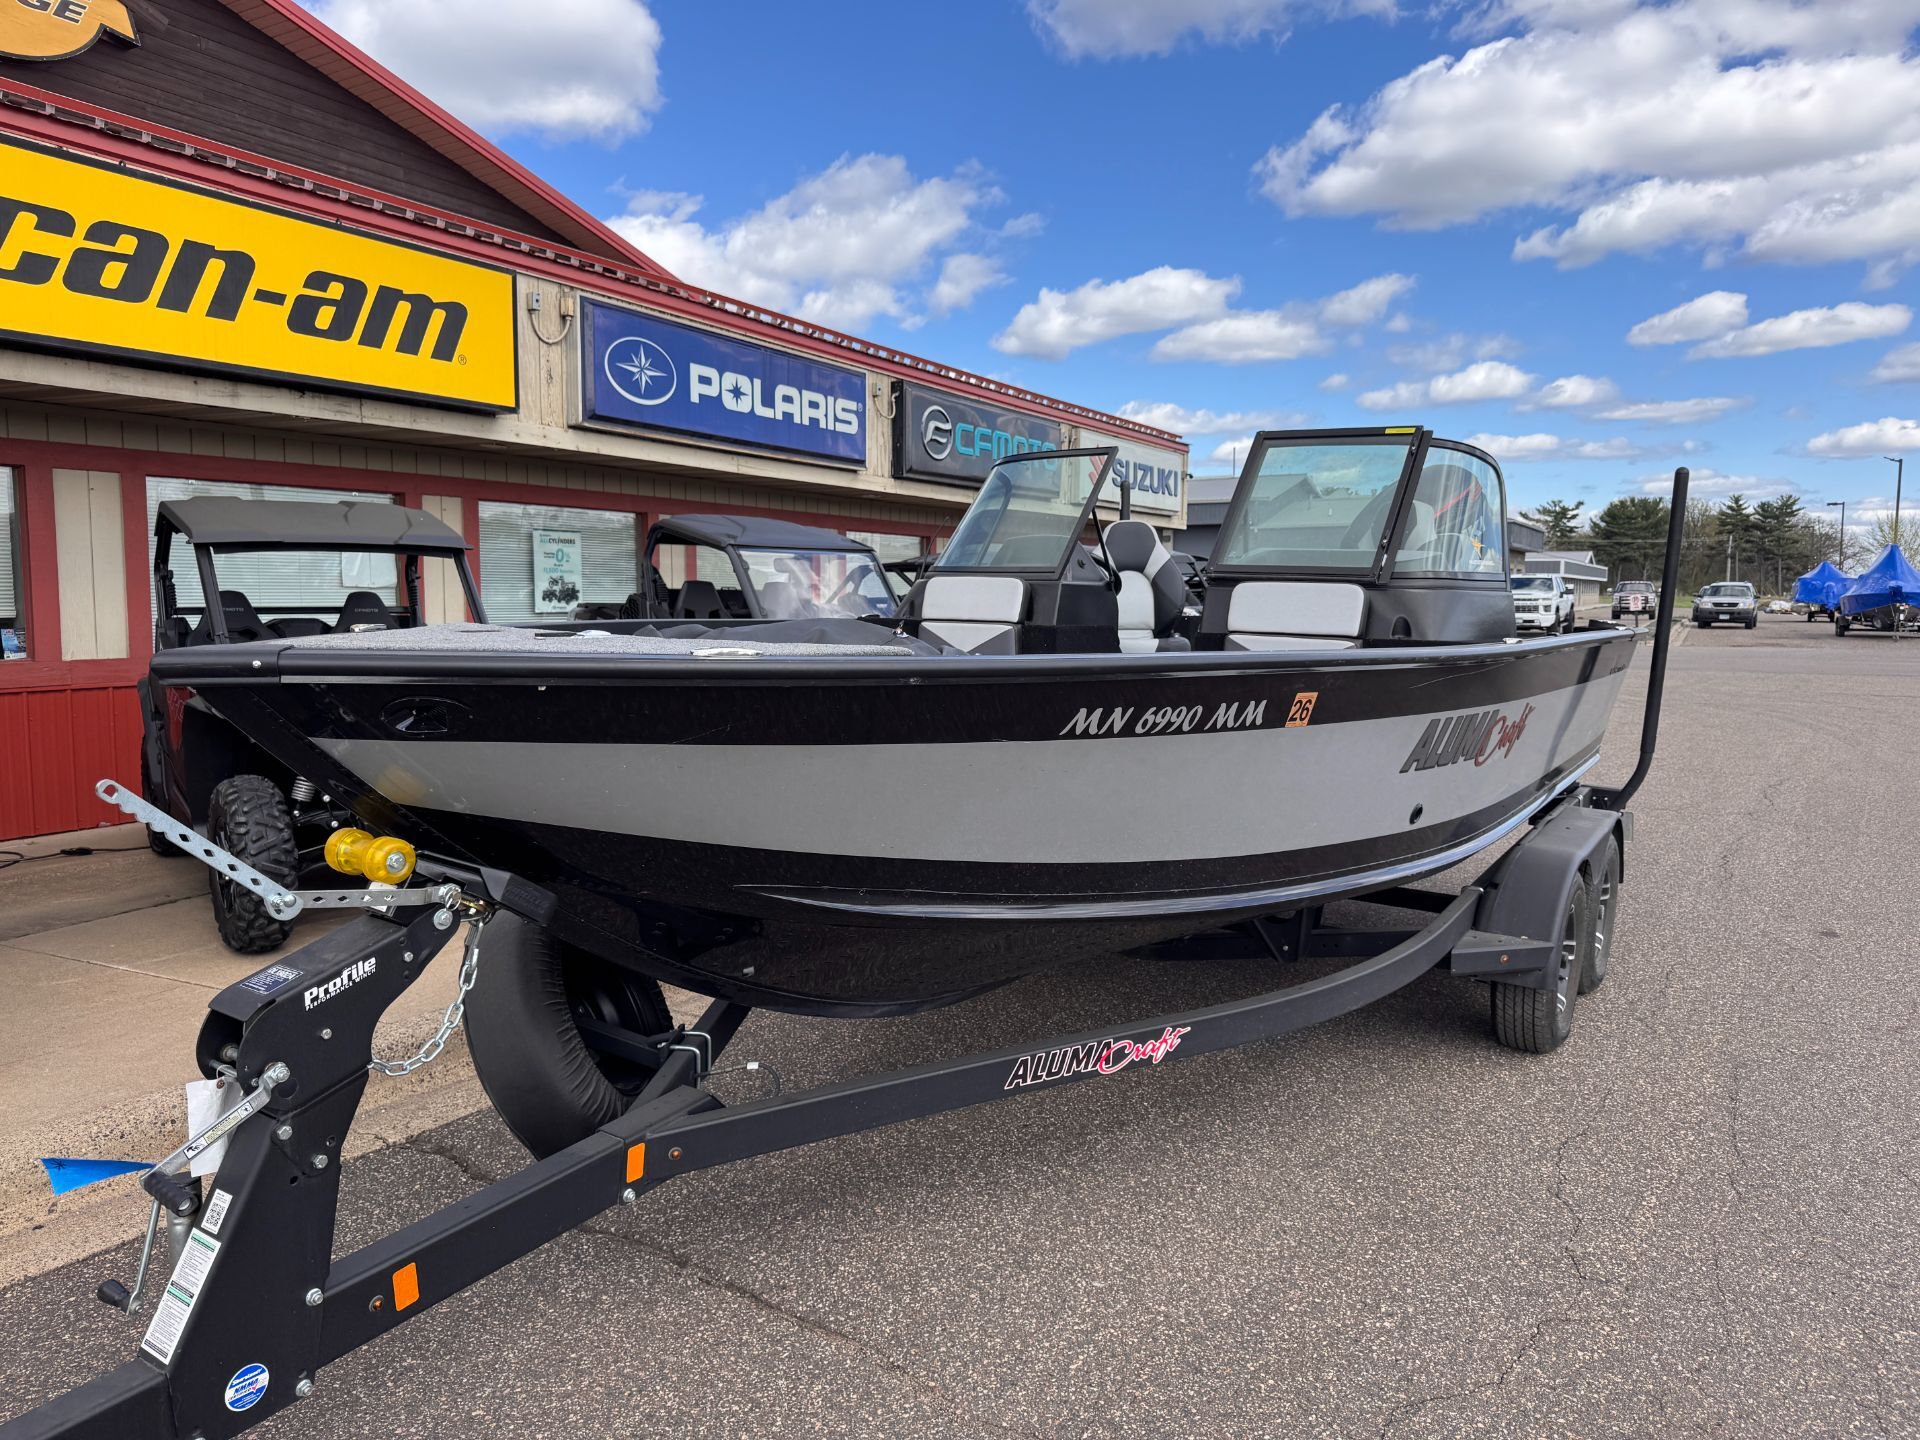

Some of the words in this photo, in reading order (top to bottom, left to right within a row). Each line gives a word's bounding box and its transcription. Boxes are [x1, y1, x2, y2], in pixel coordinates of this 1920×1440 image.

[0, 196, 469, 363] can-am
[689, 362, 859, 435] POLARIS
[955, 422, 1058, 472] CFMOTO
[1111, 458, 1179, 498] SUZUKI
[1059, 706, 1134, 736] MN
[1135, 704, 1203, 734] 6990
[1204, 699, 1268, 731] MM
[1287, 698, 1313, 722] 26
[303, 956, 377, 1007] Profile
[305, 979, 354, 1012] PERFORMANCE
[354, 967, 377, 987] WINCH
